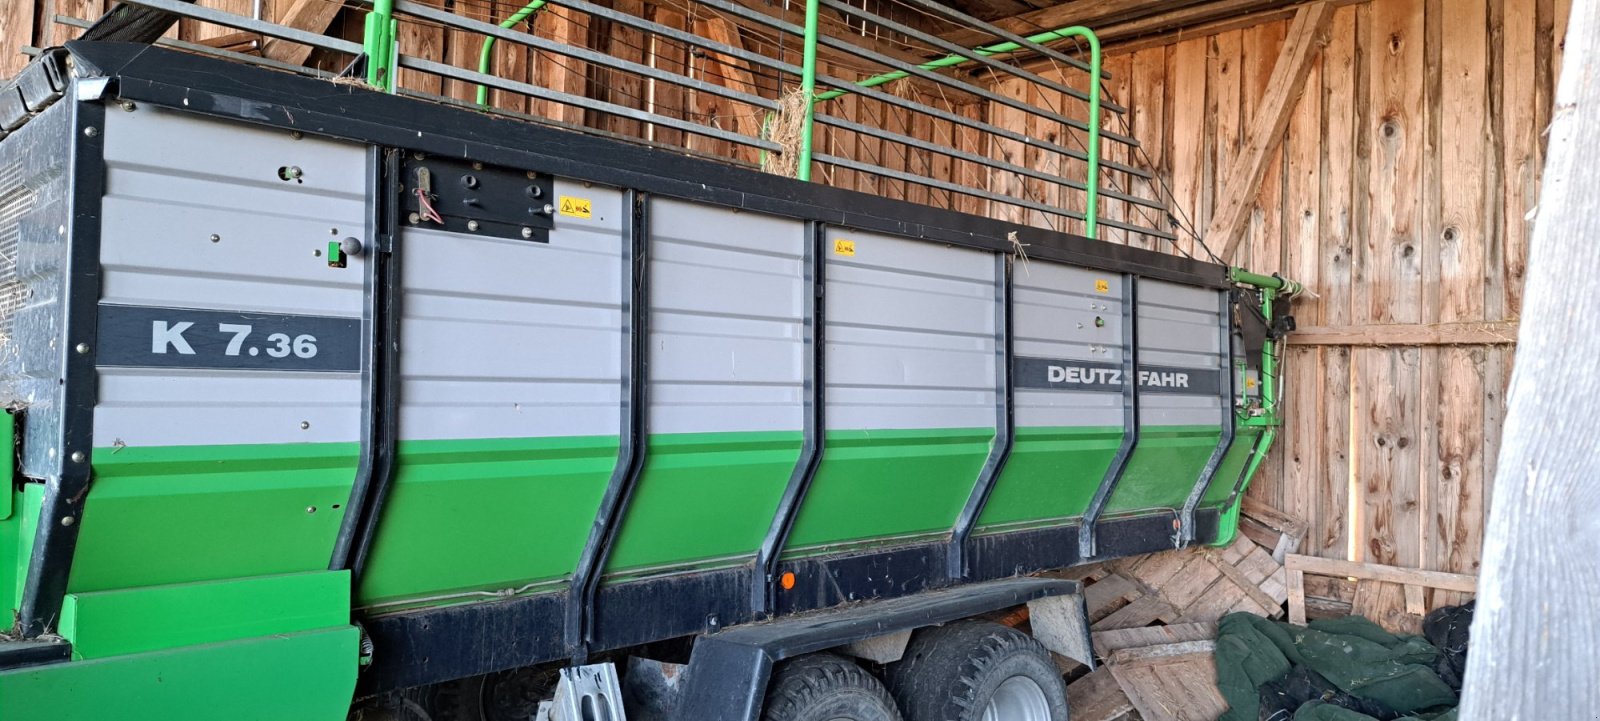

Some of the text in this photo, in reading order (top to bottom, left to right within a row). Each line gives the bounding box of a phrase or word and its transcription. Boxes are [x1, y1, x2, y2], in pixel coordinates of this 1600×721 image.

[152, 321, 318, 358] K 7.36
[1048, 366, 1189, 388] DEUTZ FAHR
